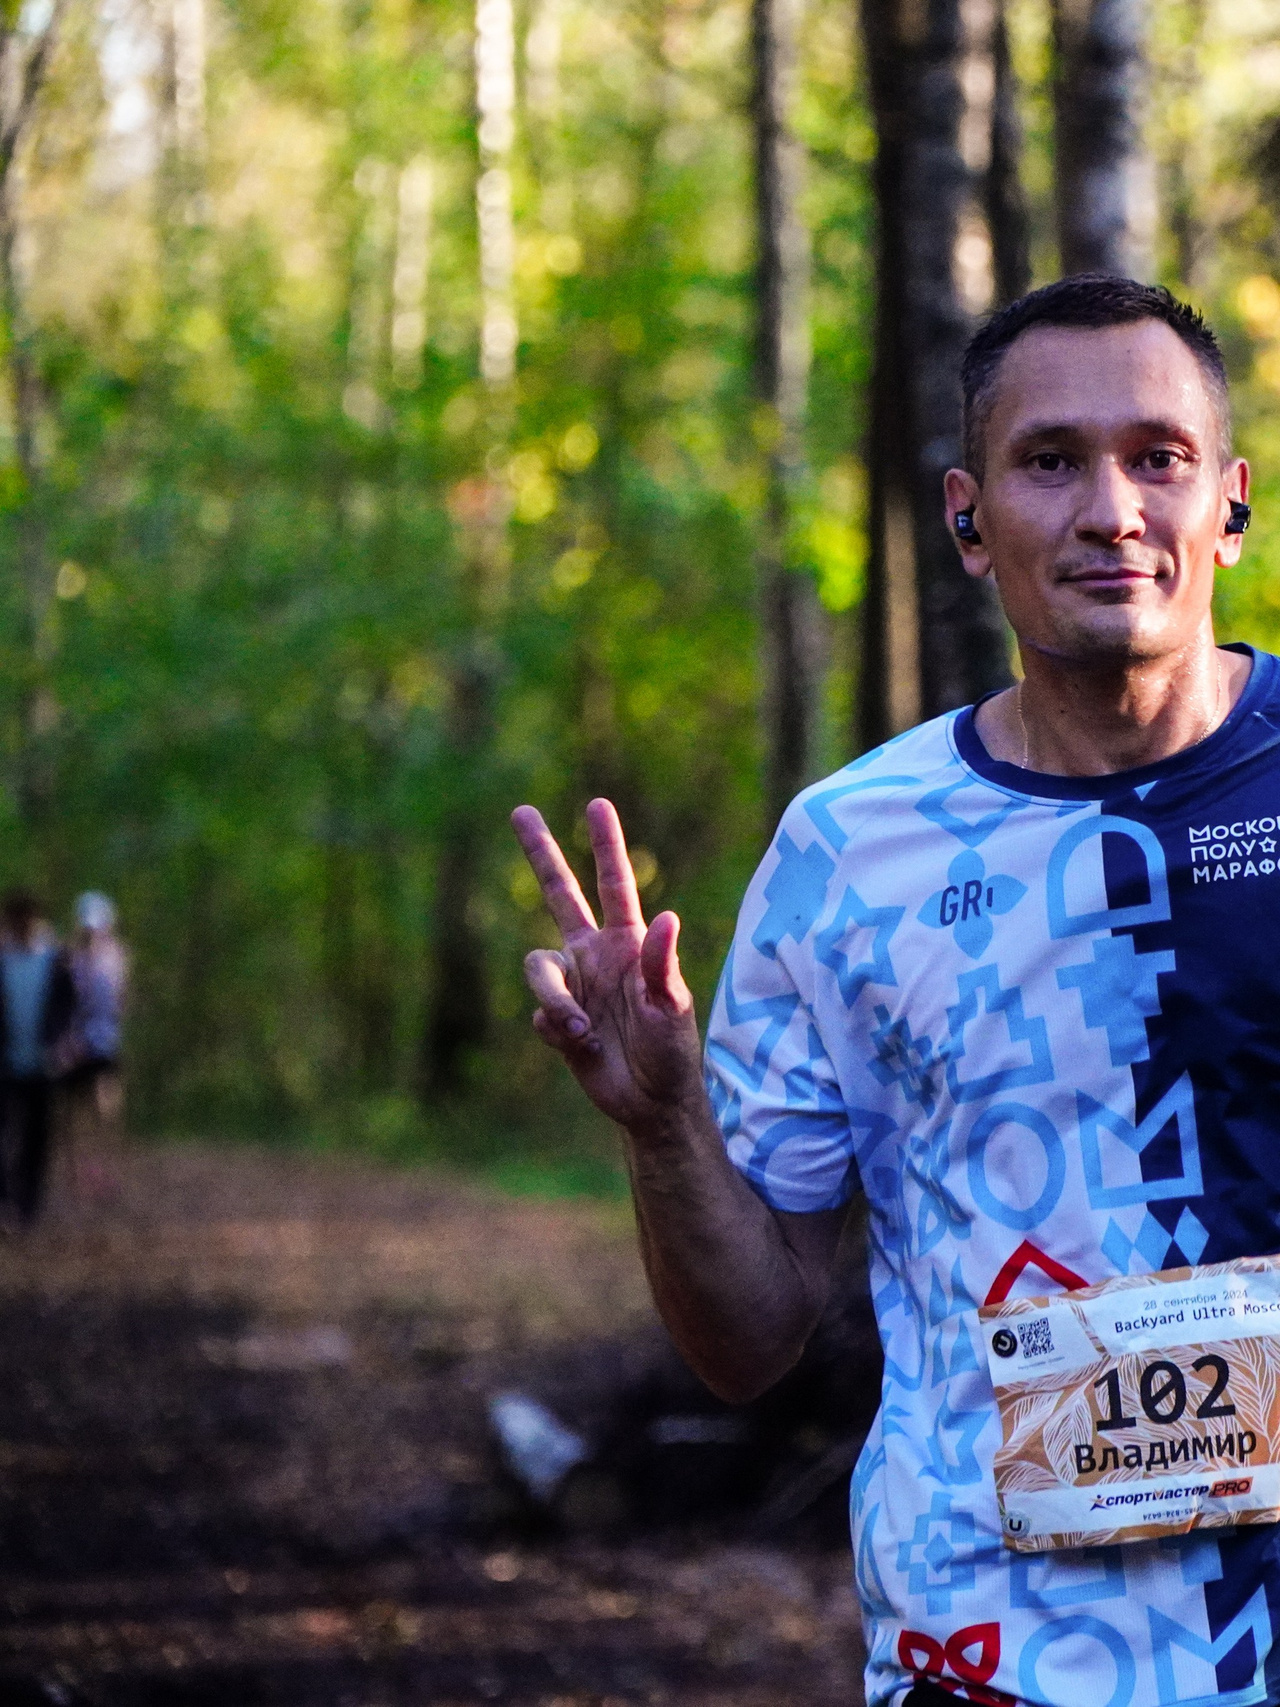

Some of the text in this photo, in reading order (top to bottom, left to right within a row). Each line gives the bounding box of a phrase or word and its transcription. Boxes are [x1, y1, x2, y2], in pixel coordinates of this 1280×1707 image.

[1190, 842, 1257, 863] ПОЛУ
[1143, 1290, 1248, 1311] 28 сентября 2024
[1115, 1311, 1185, 1333] Backyard
[1193, 1306, 1236, 1321] Ultra
[1094, 1354, 1236, 1430] 102
[1074, 1430, 1257, 1474] Владимир
[1213, 1480, 1250, 1494] PRO
